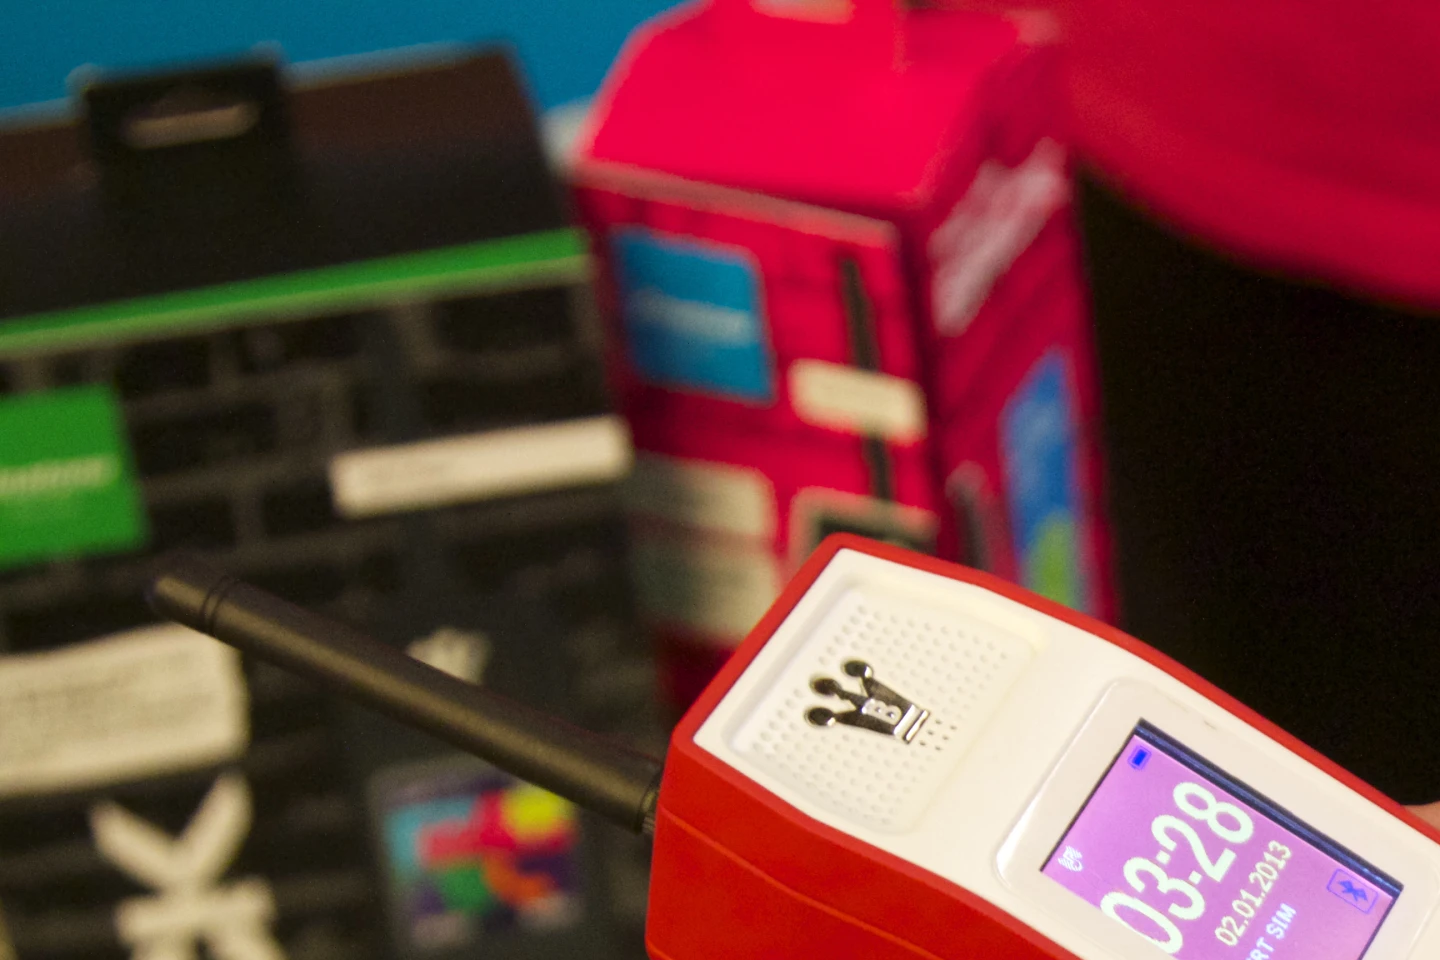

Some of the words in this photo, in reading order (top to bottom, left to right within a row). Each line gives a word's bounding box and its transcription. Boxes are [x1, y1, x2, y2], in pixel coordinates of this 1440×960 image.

[1100, 781, 1254, 954] 03:28
[1214, 840, 1292, 947] 02.01.2013
[1265, 902, 1297, 940] SIM
